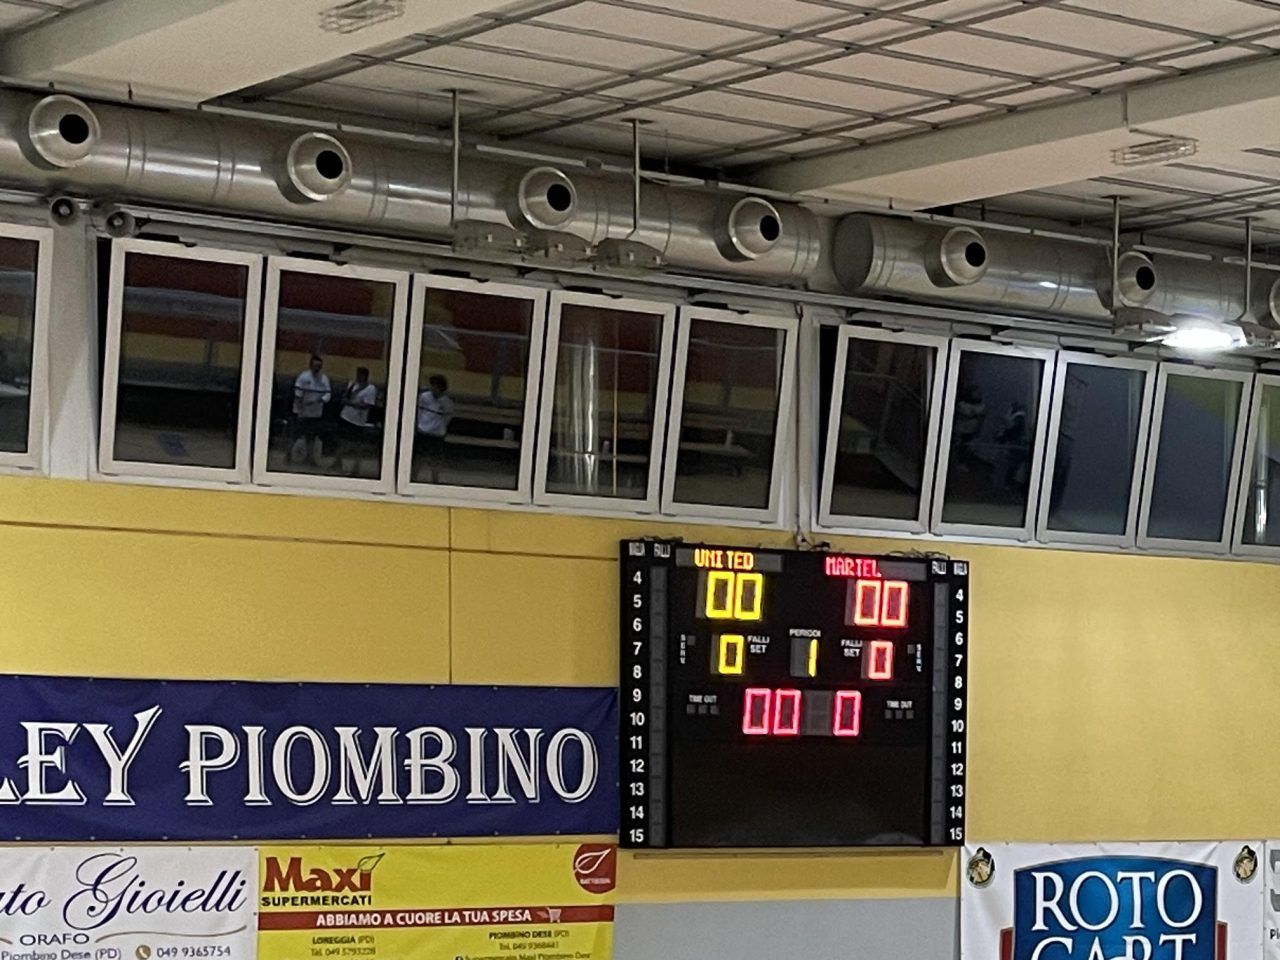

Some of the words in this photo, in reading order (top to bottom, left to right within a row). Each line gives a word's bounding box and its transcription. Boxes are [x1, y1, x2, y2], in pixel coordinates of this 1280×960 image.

[694, 548, 754, 570] UNITED
[825, 556, 882, 577] MARTEL
[633, 571, 642, 584] 4
[633, 594, 642, 608] 5
[706, 571, 763, 620] 00
[955, 588, 964, 601] 4
[854, 580, 909, 627] 00
[955, 610, 964, 623] 5
[633, 618, 642, 631] 6
[955, 632, 964, 645] 6
[633, 641, 642, 655] 7
[719, 634, 745, 674] 0
[750, 645, 767, 653] SET
[808, 639, 819, 678] 1
[868, 640, 894, 680] 0
[954, 654, 963, 667] 7
[633, 665, 642, 679] 8
[954, 675, 963, 689] 8
[633, 688, 642, 702] 9
[954, 697, 962, 711] 9
[742, 688, 802, 735] 00
[833, 690, 861, 737] 0
[630, 712, 645, 726] 10
[951, 719, 964, 733] 10
[630, 735, 643, 749] 11
[951, 741, 962, 754] 11
[0, 704, 162, 806] EY
[179, 725, 599, 806] PIOMBINO
[630, 759, 645, 773] 12
[950, 763, 963, 776] 12
[630, 782, 645, 796] 13
[950, 784, 963, 797] 13
[630, 805, 644, 819] 14
[950, 806, 962, 819] 14
[630, 829, 644, 842] 15
[950, 827, 962, 840] 15
[263, 856, 372, 892] Maxi
[63, 853, 247, 930] Gioielli
[261, 894, 372, 907] SUPERMERCATI
[1031, 869, 1203, 931] ROTO
[316, 913, 381, 927] ABBIAMO
[384, 914, 393, 926] A
[397, 911, 442, 925] CUORE
[445, 911, 460, 924] LA
[463, 910, 490, 923] TUA
[494, 909, 532, 922] SPESA
[19, 933, 90, 946] ORAFO
[312, 935, 356, 944] LOREGGIA
[61, 950, 91, 960] Dese
[156, 947, 178, 958] 049
[181, 945, 231, 957] 9365754
